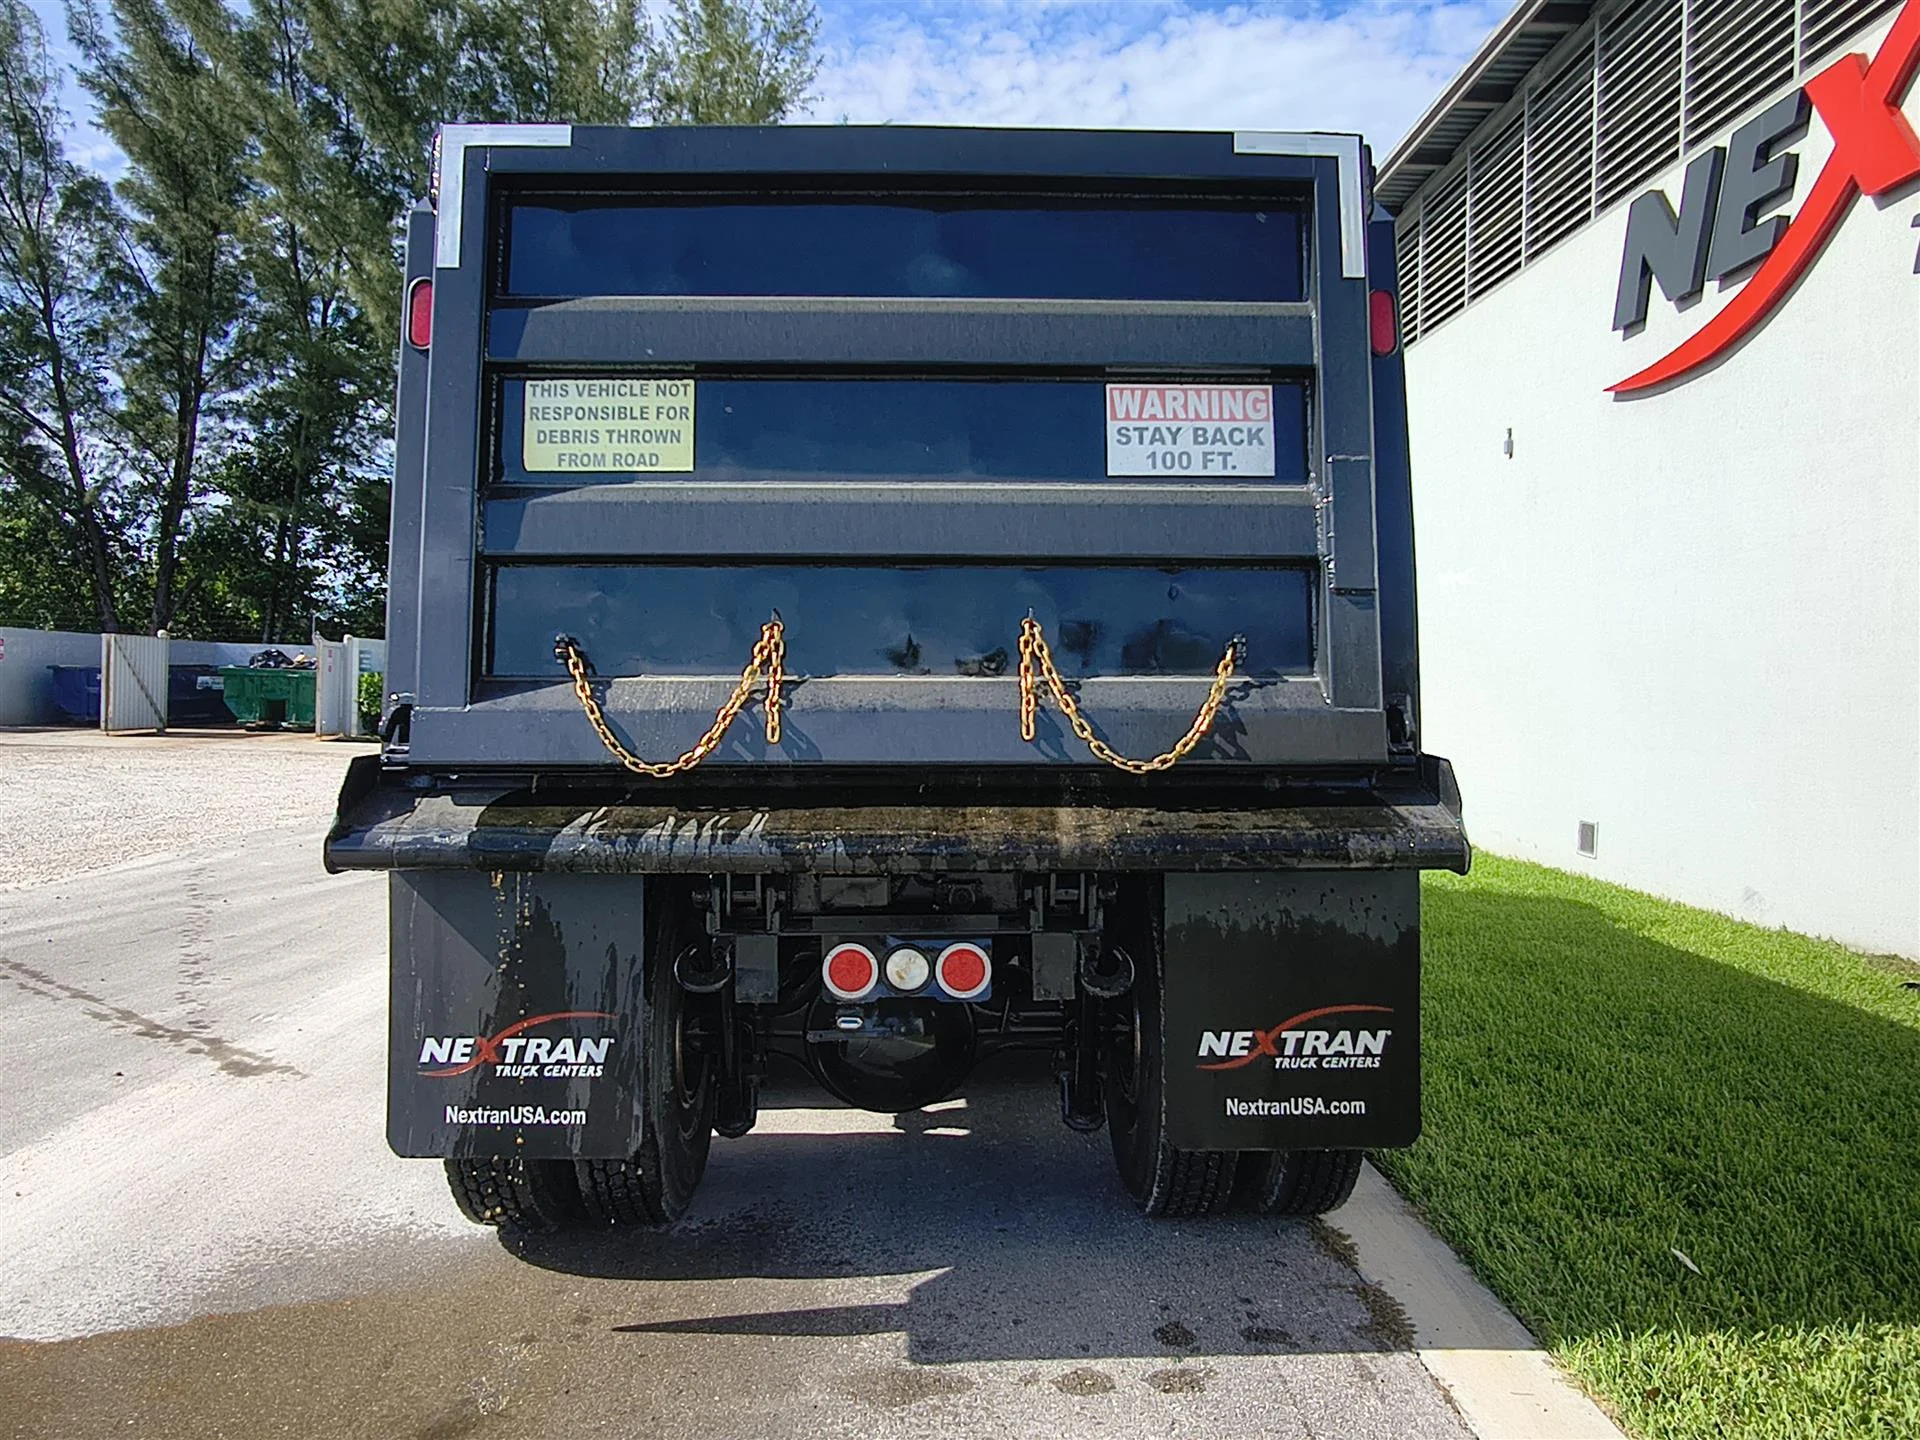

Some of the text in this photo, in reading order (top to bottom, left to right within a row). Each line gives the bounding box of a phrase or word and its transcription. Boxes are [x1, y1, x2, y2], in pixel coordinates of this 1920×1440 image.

[529, 383, 691, 398] THIS VEHICLE NOT
[529, 406, 690, 421] RESPONSIBLE FOR
[1111, 389, 1269, 420] WARNING
[536, 429, 682, 444] DEBRIS THROWN
[1115, 426, 1265, 446] STAY BACK
[557, 452, 660, 467] FROM ROAD
[1145, 451, 1237, 470] 100 FT.
[418, 1036, 611, 1064] NEXTRAN
[1197, 1029, 1388, 1057] NEXTRAN
[495, 1065, 604, 1078] TRUCK CENTERS
[1274, 1056, 1382, 1070] TRUCK CENTERS
[445, 1105, 587, 1125] NextranUSA.com
[1225, 1097, 1366, 1117] NextranUSA.com
